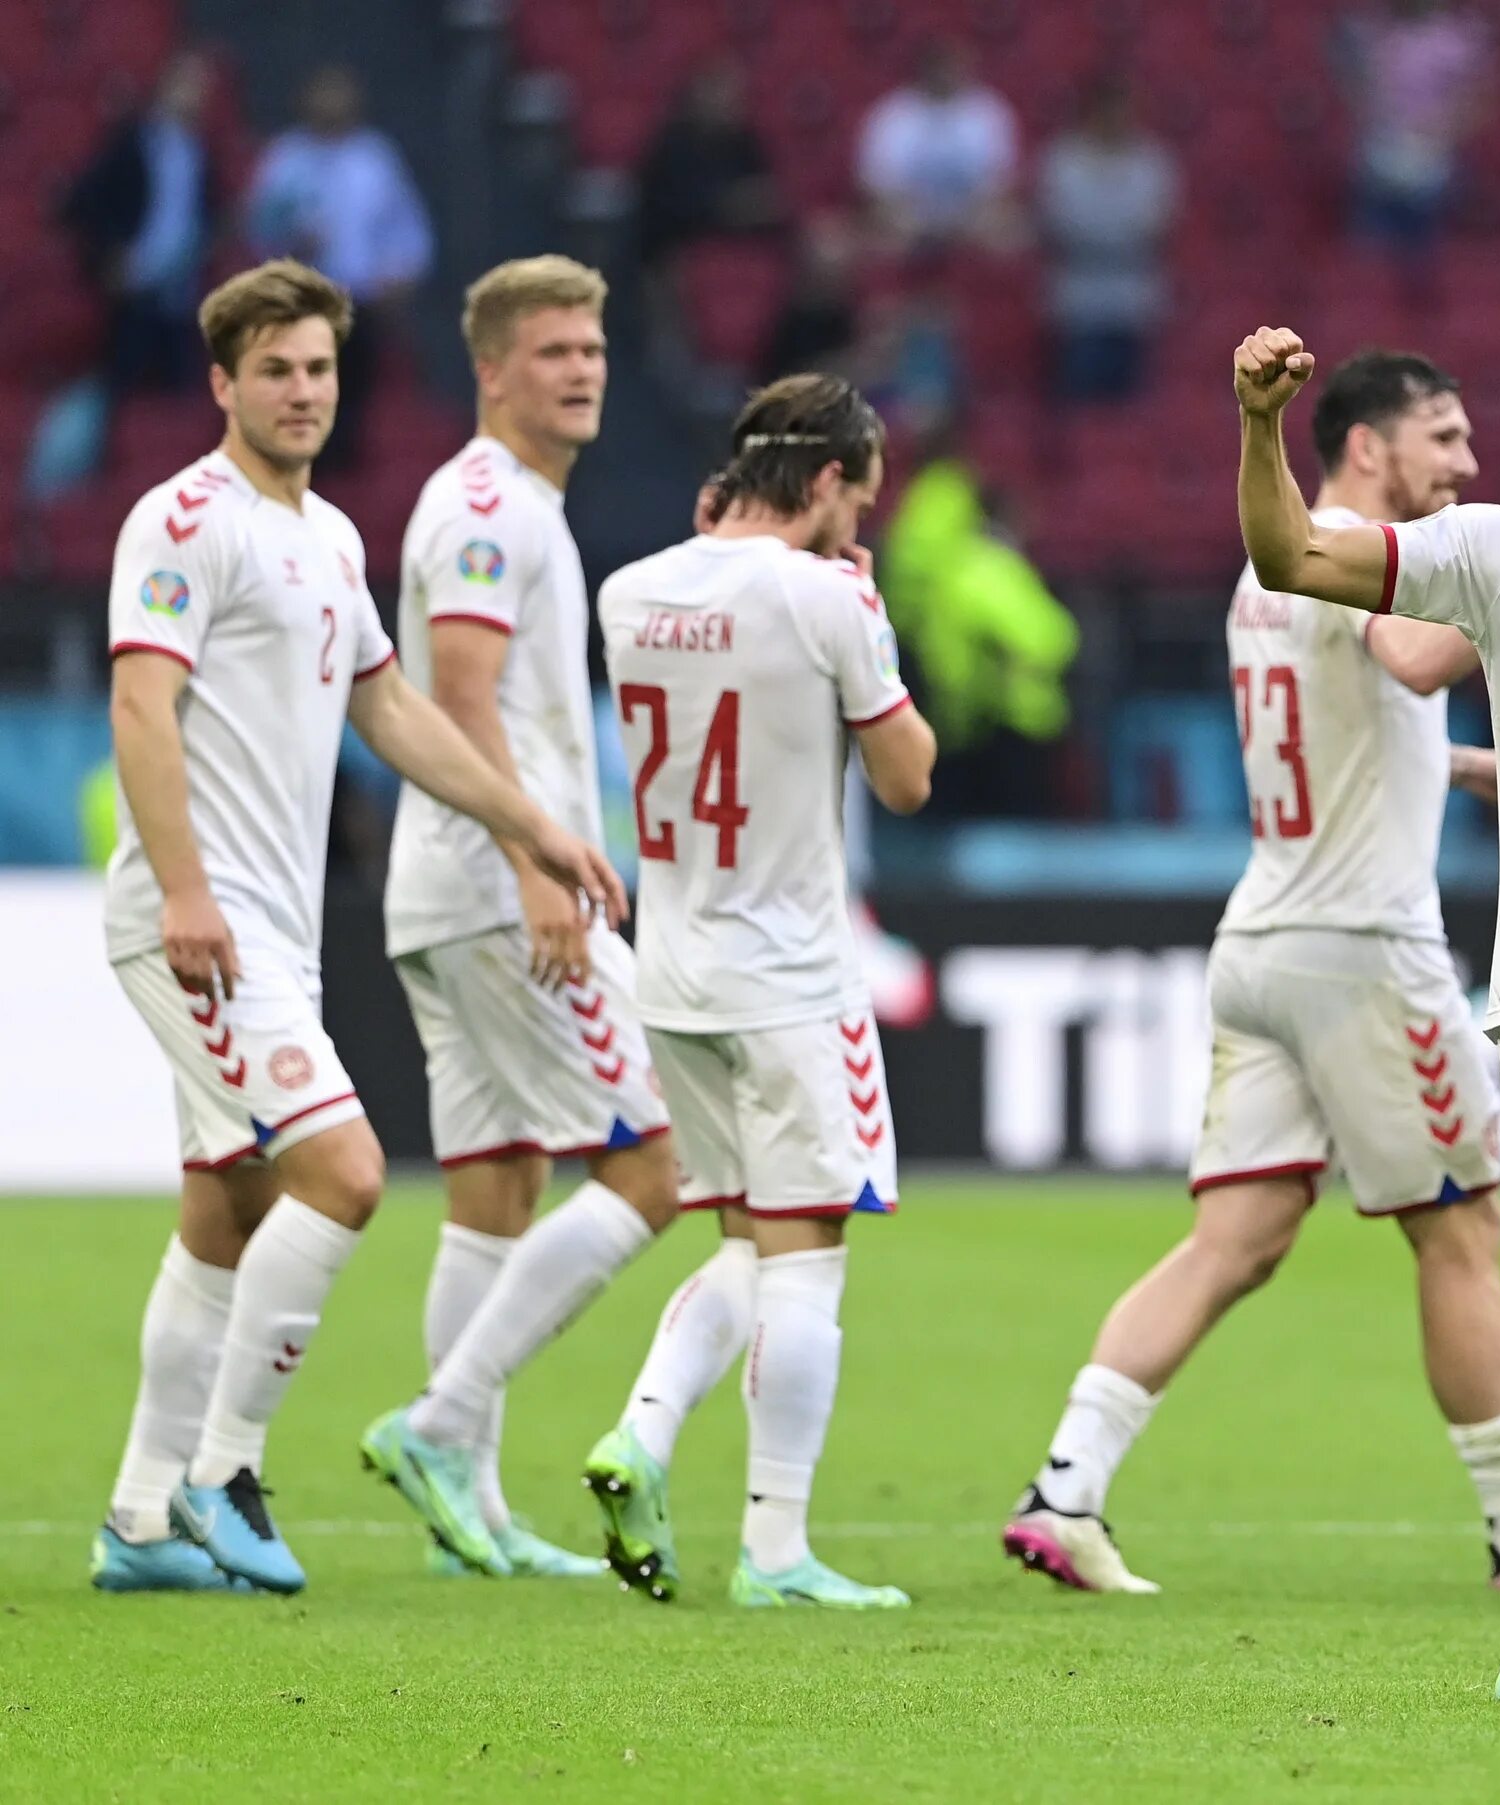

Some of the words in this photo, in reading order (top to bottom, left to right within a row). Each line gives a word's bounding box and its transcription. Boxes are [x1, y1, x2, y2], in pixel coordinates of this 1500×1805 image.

[321, 606, 336, 683] 2
[635, 612, 734, 651] JENSEN
[619, 683, 750, 868] 24
[1234, 667, 1312, 839] 23
